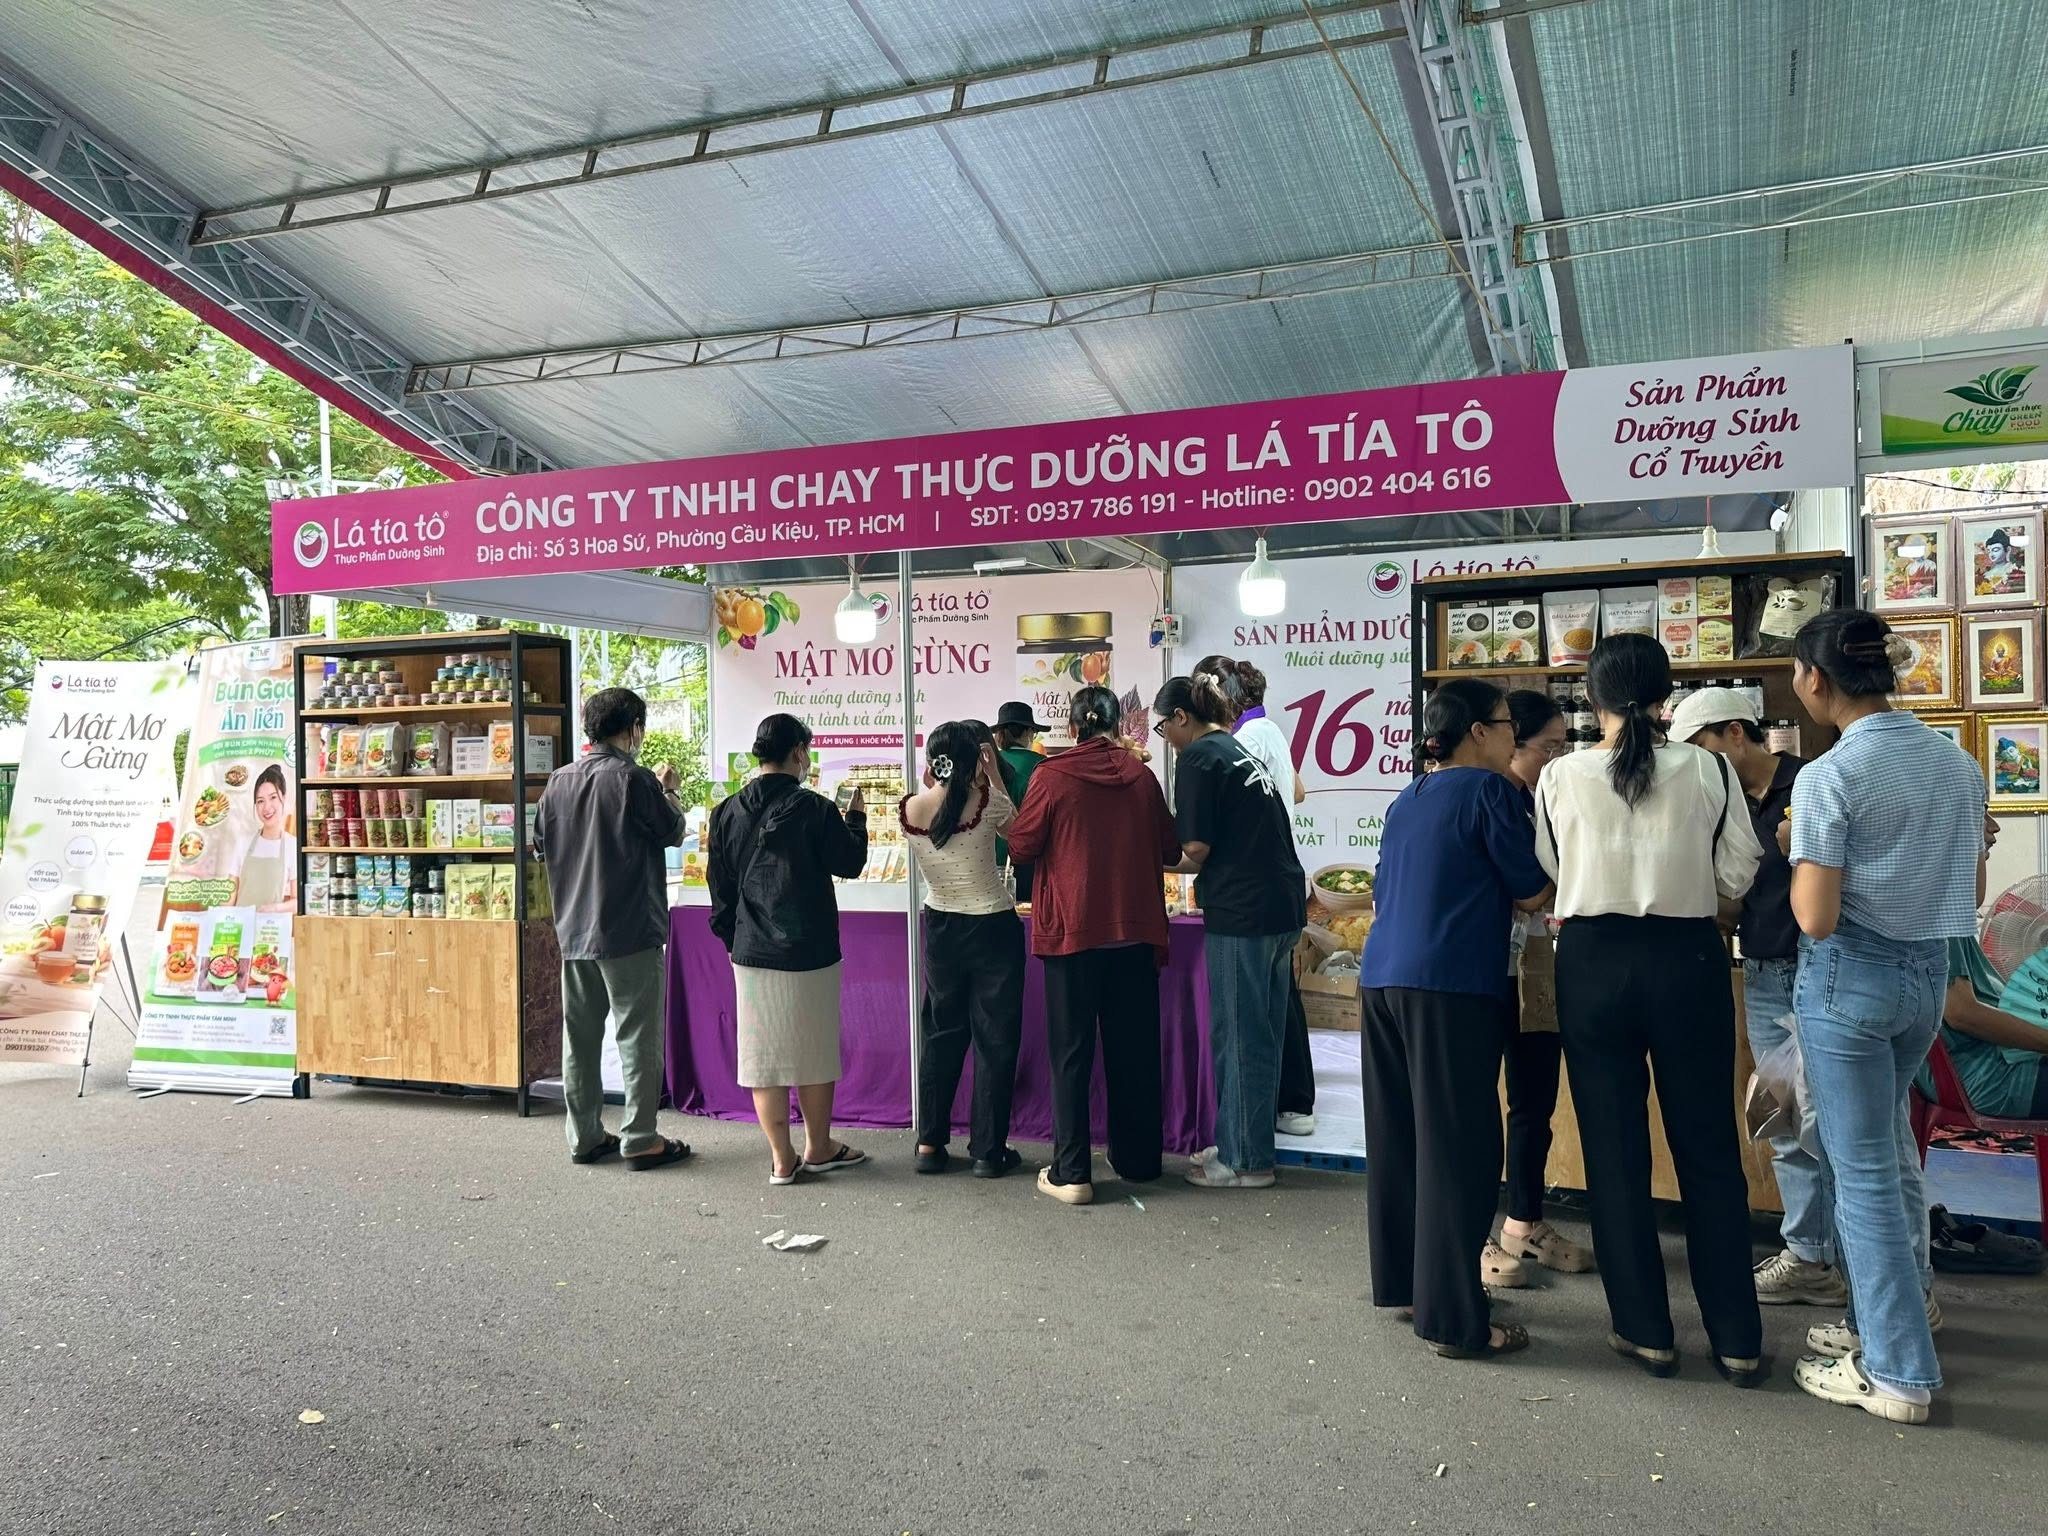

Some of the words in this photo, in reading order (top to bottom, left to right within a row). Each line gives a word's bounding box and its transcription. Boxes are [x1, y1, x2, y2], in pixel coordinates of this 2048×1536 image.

[1625, 378, 1685, 408] Sản
[1695, 366, 1788, 402] Phẩm
[1614, 415, 1717, 444] Dưỡng
[1727, 407, 1800, 436] Sinh
[2011, 420, 2041, 428] FOOD
[476, 492, 575, 534] CÔNG
[588, 488, 636, 523] TY
[648, 481, 756, 520] TNHH
[770, 467, 880, 510] CHAY
[894, 453, 1014, 501] THỰC
[1031, 434, 1206, 488] DƯỠNG
[1227, 420, 1291, 472] LÁ
[1308, 413, 1398, 463] TÍA
[1416, 399, 1493, 454] TÔ
[1629, 446, 1672, 478] Cổ
[1680, 440, 1784, 479] Truyền
[477, 545, 504, 564] Địa
[508, 540, 538, 561] chỉ:
[544, 537, 565, 558] Số
[569, 538, 579, 556] 3
[584, 536, 618, 554] Hoa
[622, 533, 650, 553] Sứ,
[657, 528, 726, 550] Phường
[731, 523, 766, 544] Cầu
[772, 521, 819, 542] Kiệu,
[825, 517, 853, 537] TP.
[859, 513, 904, 534] HCM
[970, 505, 1019, 527] SĐT:
[1026, 500, 1084, 523] 0937
[1090, 496, 1133, 518] 786
[1140, 492, 1176, 514] 191
[1202, 486, 1295, 509] Hotline:
[1304, 475, 1373, 501] 0902
[1381, 471, 1435, 495] 404
[1442, 465, 1491, 490] 616
[333, 517, 366, 549] Lá
[370, 518, 409, 545] tía
[334, 553, 358, 566] Thực
[360, 550, 386, 563] Phẩm
[388, 547, 421, 561] Dưỡng
[423, 544, 445, 557] Sinh
[928, 592, 959, 611] tía
[971, 612, 989, 622] Sinh
[1234, 620, 1278, 647] SẢN
[1285, 609, 1357, 645] PHẨM
[775, 640, 838, 686] MẬT
[846, 643, 895, 676] MƠ
[1284, 651, 1324, 667] Nuôi
[1329, 651, 1385, 669] dưỡng
[1389, 647, 1412, 664] sứ
[215, 677, 255, 703] Bún
[774, 690, 807, 706] Thức
[810, 687, 843, 709] uống
[847, 689, 891, 708] dưỡng
[48, 712, 117, 746] Mật
[118, 712, 167, 741] Mơ
[818, 710, 850, 727] lành
[853, 710, 869, 725] và
[1284, 688, 1375, 777] 16
[61, 745, 148, 780] Gừng
[1296, 831, 1325, 848] VẬT
